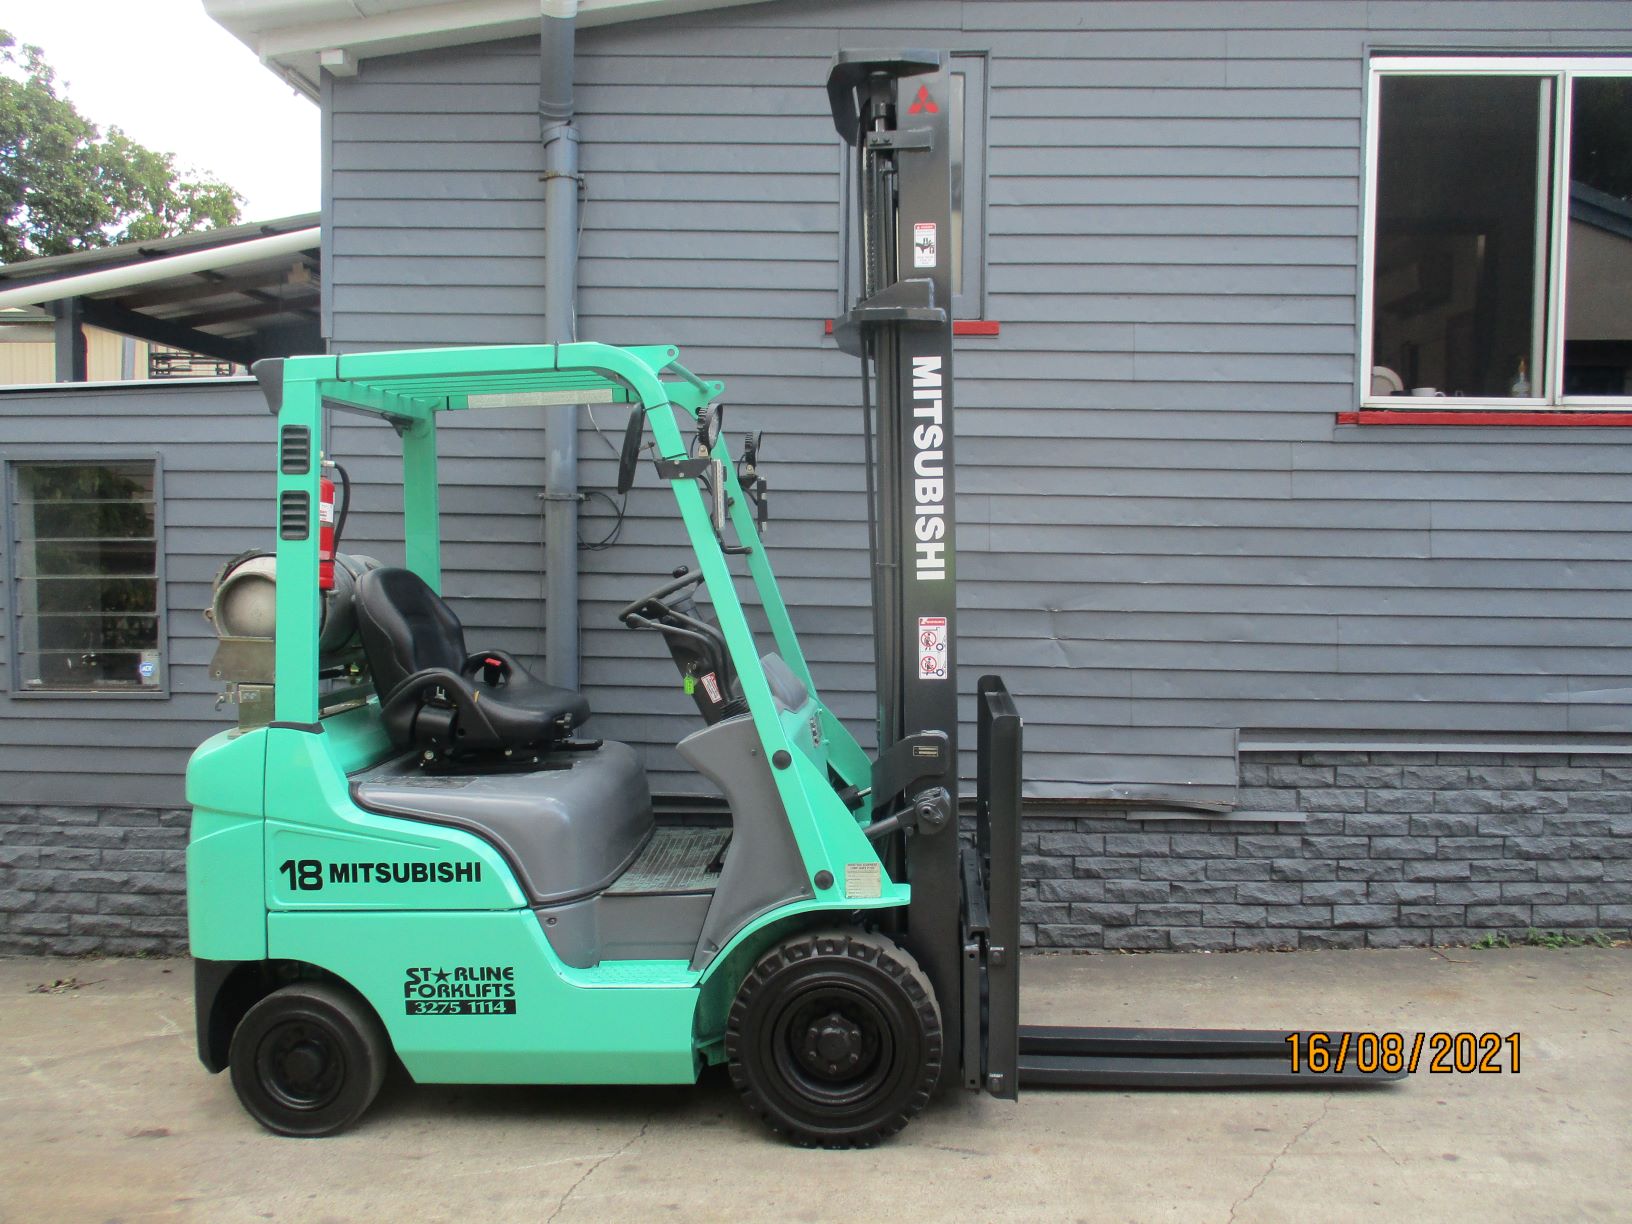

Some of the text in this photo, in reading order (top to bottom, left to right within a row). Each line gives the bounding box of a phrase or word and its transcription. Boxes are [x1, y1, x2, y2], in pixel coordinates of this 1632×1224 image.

[912, 356, 945, 580] MITSUBISHI
[279, 859, 481, 890] 18 MITSUBISHI
[404, 981, 515, 998] FORKLIFTS
[415, 1001, 506, 1014] 3275 1114
